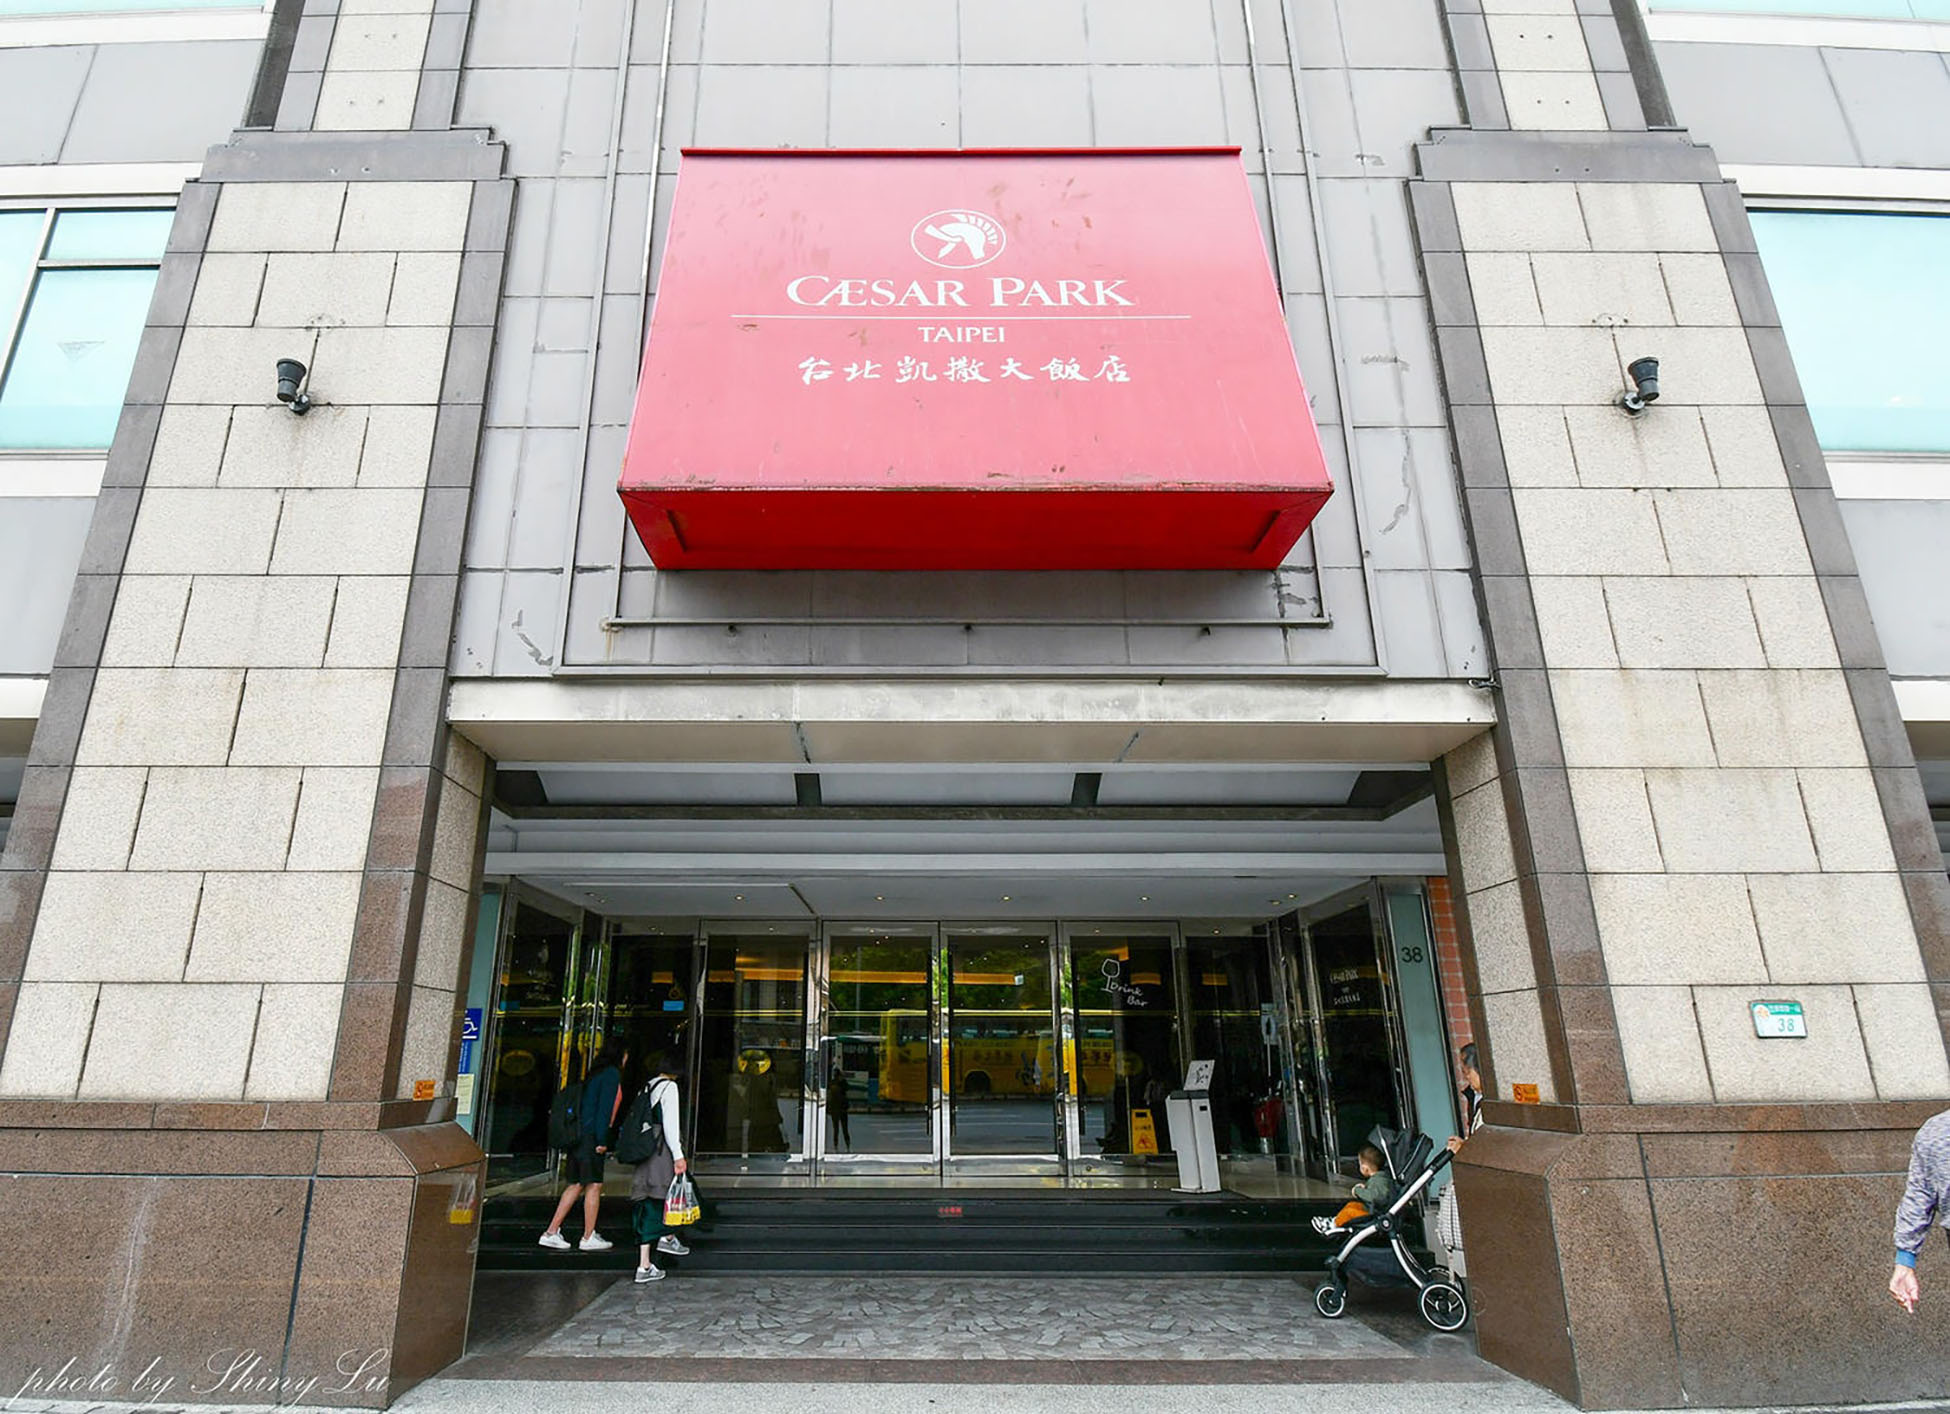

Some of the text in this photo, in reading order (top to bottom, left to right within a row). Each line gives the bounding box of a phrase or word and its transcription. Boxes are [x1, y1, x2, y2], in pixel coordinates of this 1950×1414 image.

[786, 275, 1136, 307] CÆSAR PARK
[917, 326, 1006, 343] TAIPEI
[798, 355, 1132, 385] 台北凱撒大飯店
[1401, 946, 1423, 963] 38
[1127, 995, 1149, 1007] Bar
[1777, 1018, 1795, 1032] 38
